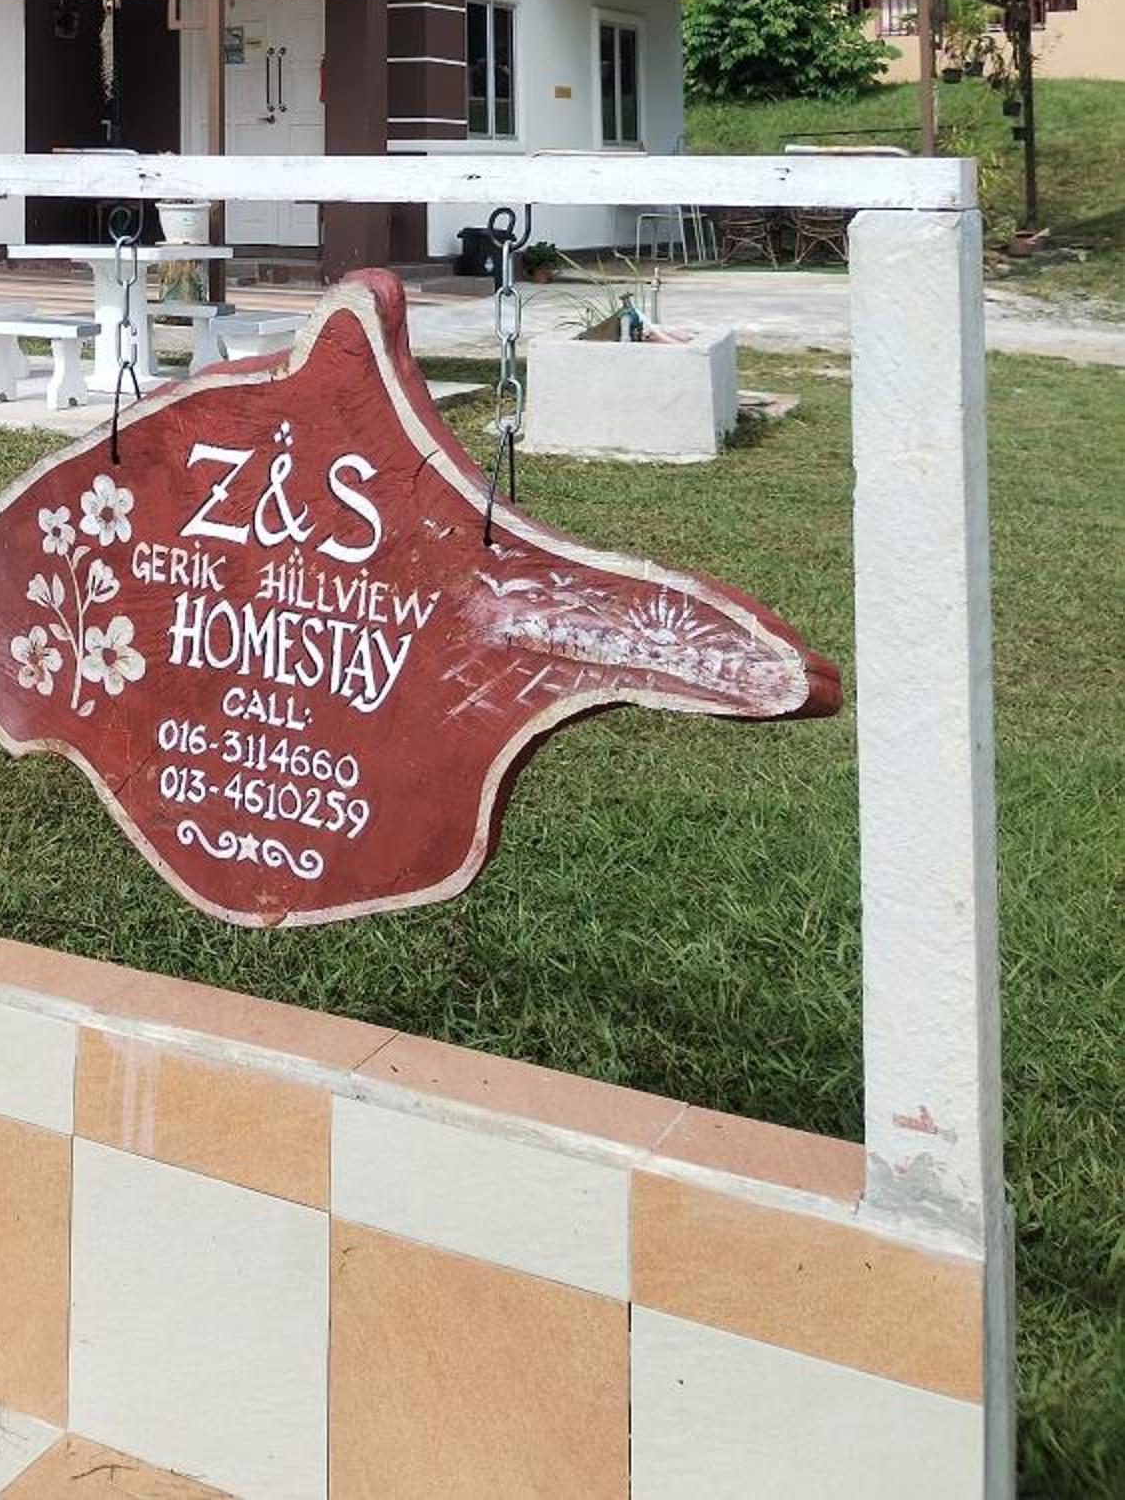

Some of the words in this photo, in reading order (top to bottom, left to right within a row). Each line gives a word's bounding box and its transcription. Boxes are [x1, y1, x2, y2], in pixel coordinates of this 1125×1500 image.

[167, 591, 412, 713] HOMESTAY
[221, 687, 313, 730] CALL:
[157, 718, 359, 788] 016-3114660
[159, 765, 370, 839] 013-4610259
